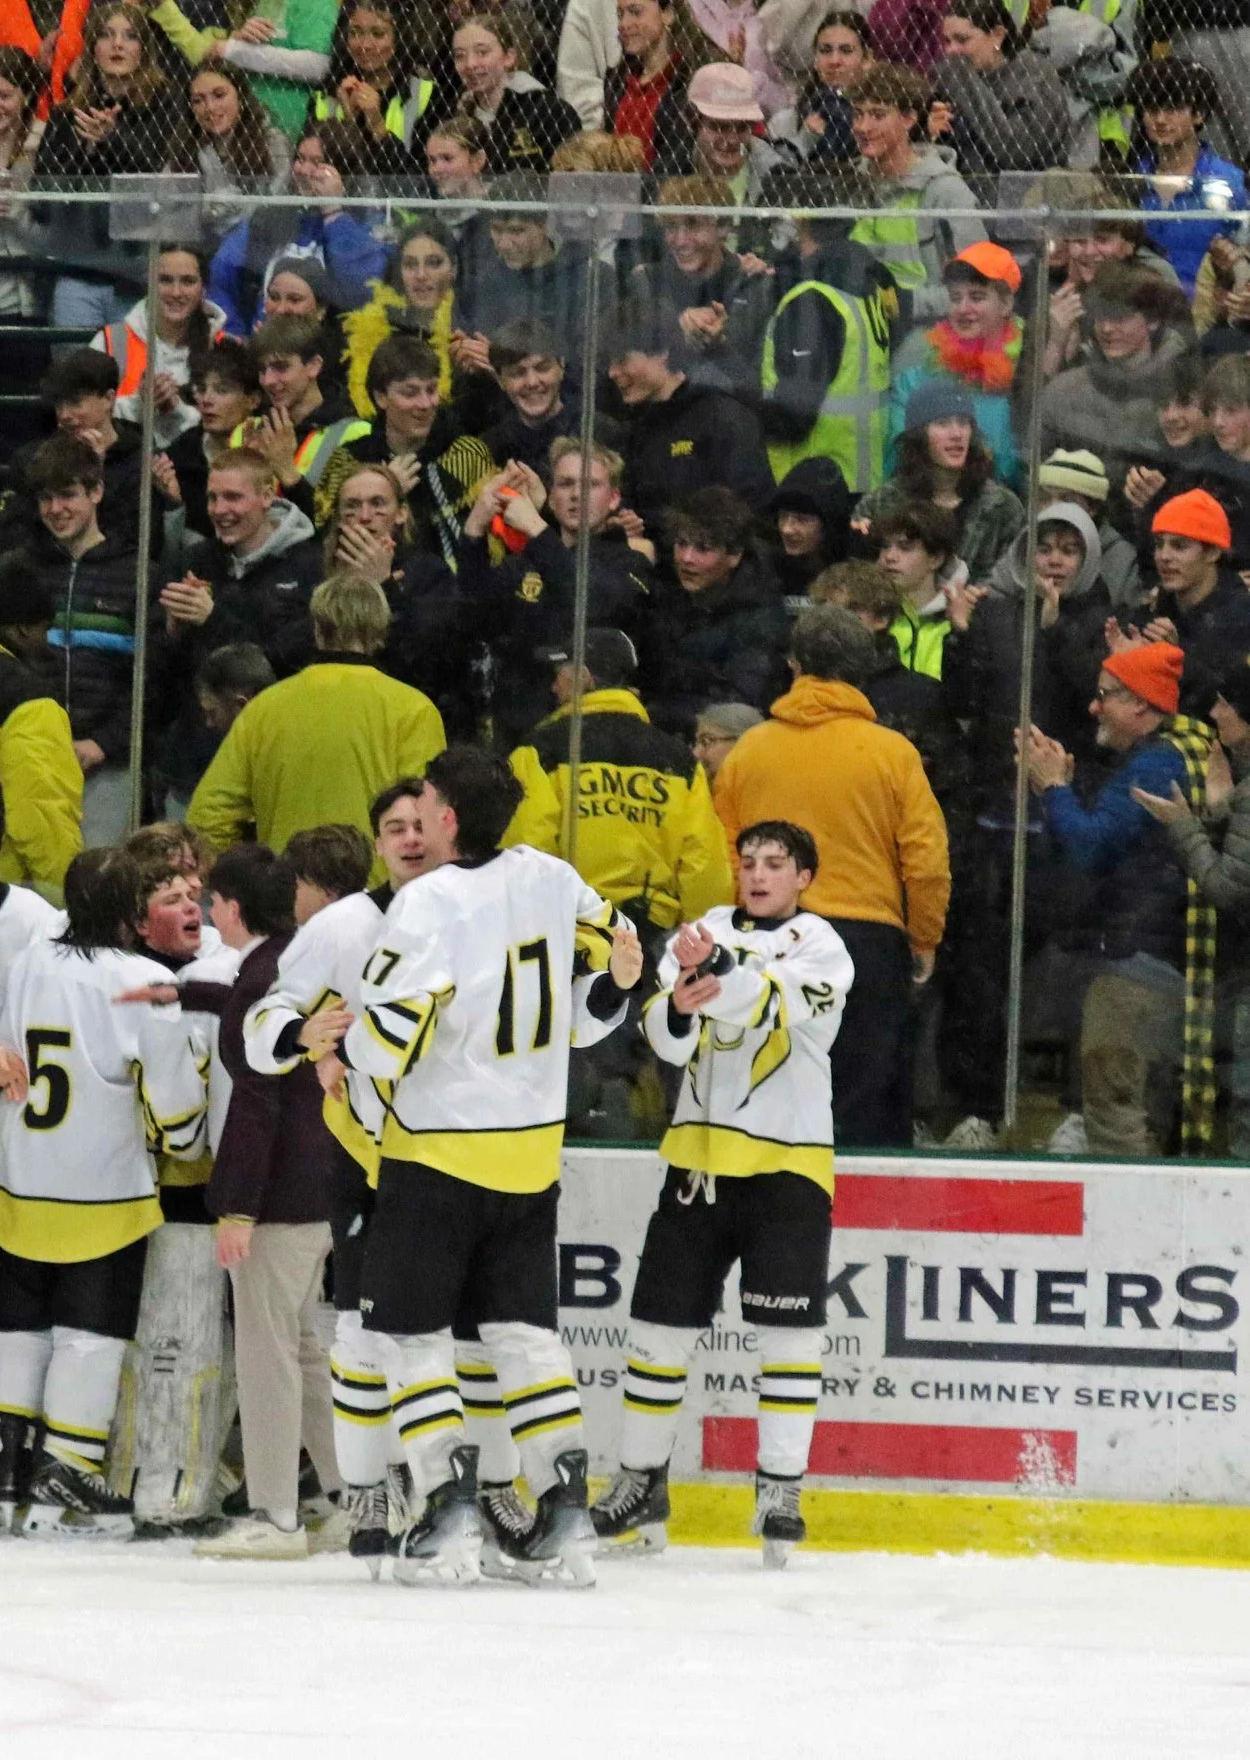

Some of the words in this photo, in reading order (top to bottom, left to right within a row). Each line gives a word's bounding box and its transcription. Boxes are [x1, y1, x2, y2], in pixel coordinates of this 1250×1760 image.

[578, 768, 670, 805] GMCS
[495, 934, 554, 1058] 17
[23, 1026, 72, 1132] 5
[742, 1291, 811, 1311] BAUER
[872, 1376, 897, 1398] &
[910, 1380, 1062, 1405] CHIMNEY
[1074, 1387, 1238, 1413] SERVICES
